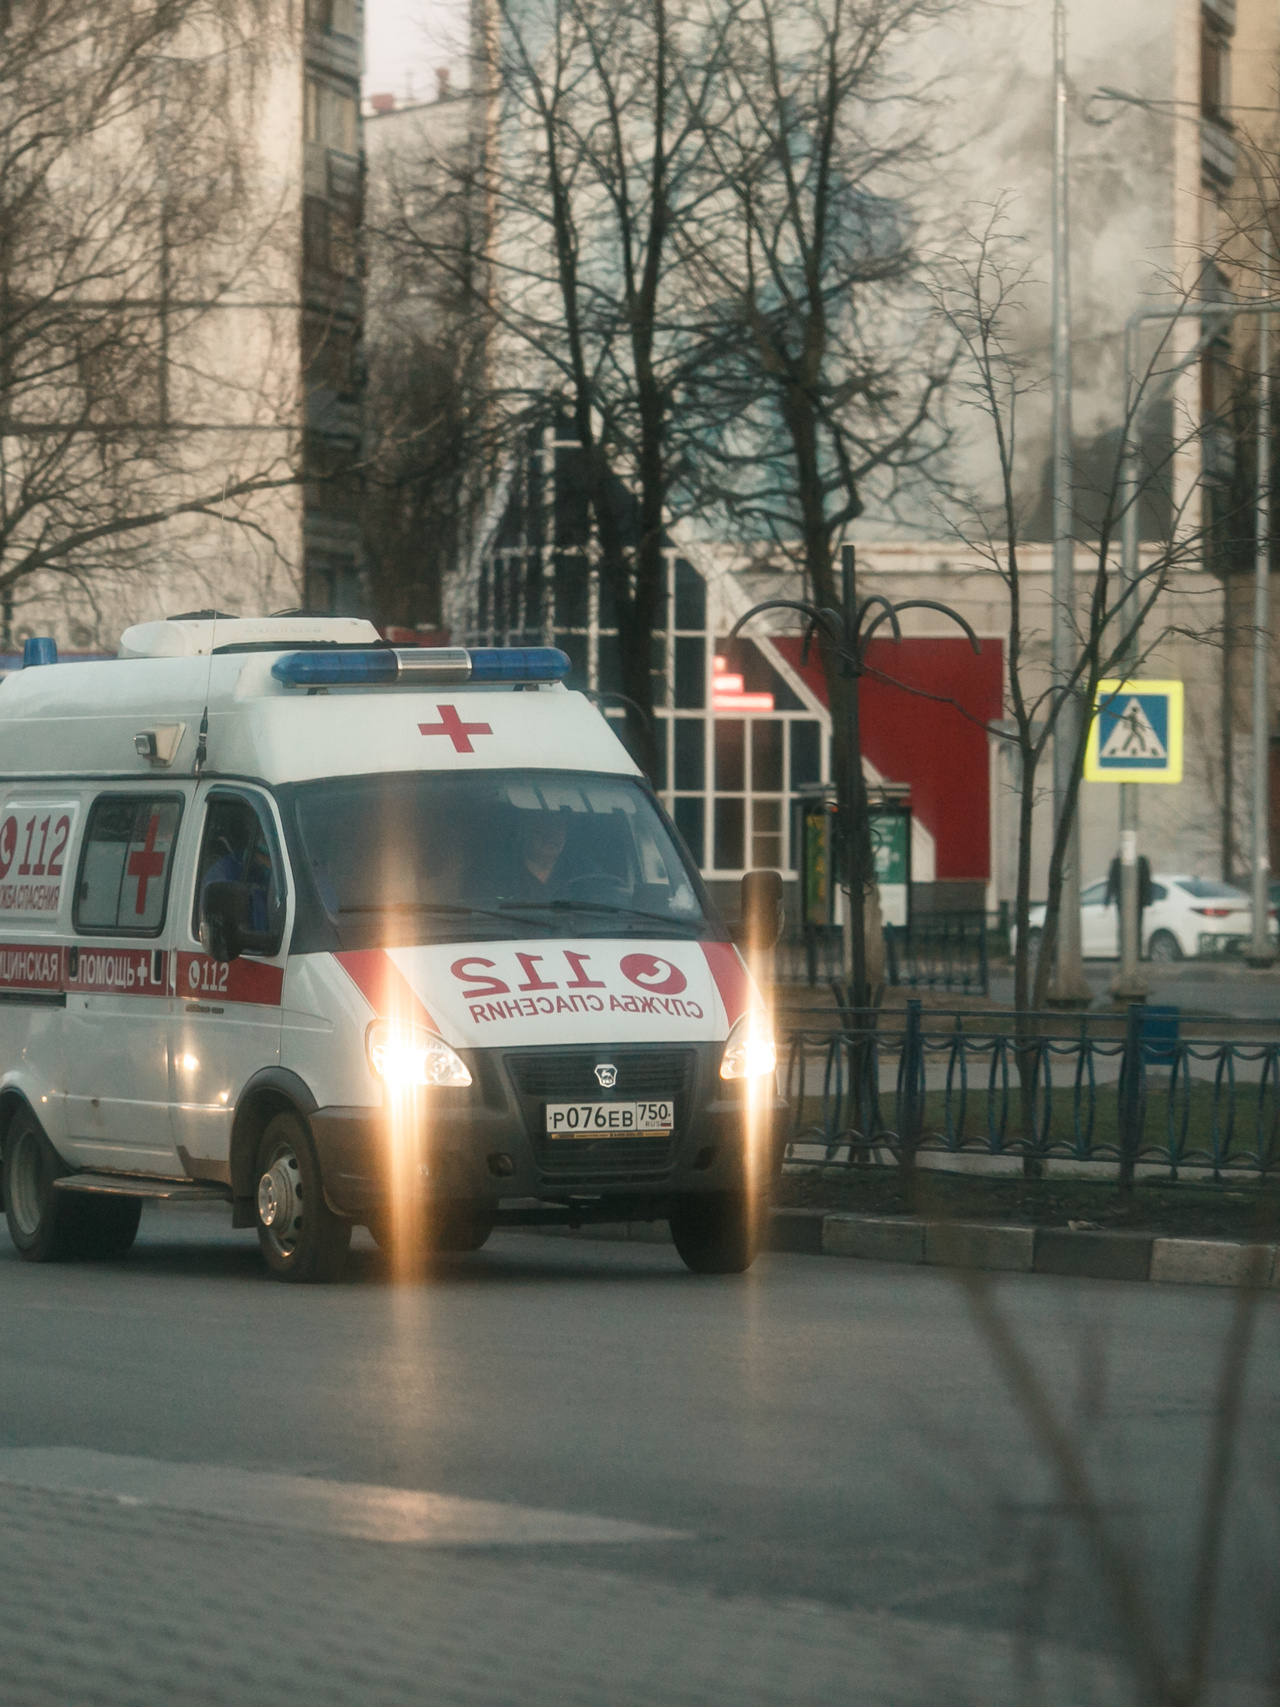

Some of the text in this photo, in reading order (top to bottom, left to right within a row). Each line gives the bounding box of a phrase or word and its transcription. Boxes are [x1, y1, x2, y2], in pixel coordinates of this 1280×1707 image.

[18, 815, 70, 876] 112
[79, 955, 135, 988] ПОМОЩЬ
[201, 961, 230, 992] 112
[553, 1103, 668, 1129] Р076ЕВ 750
